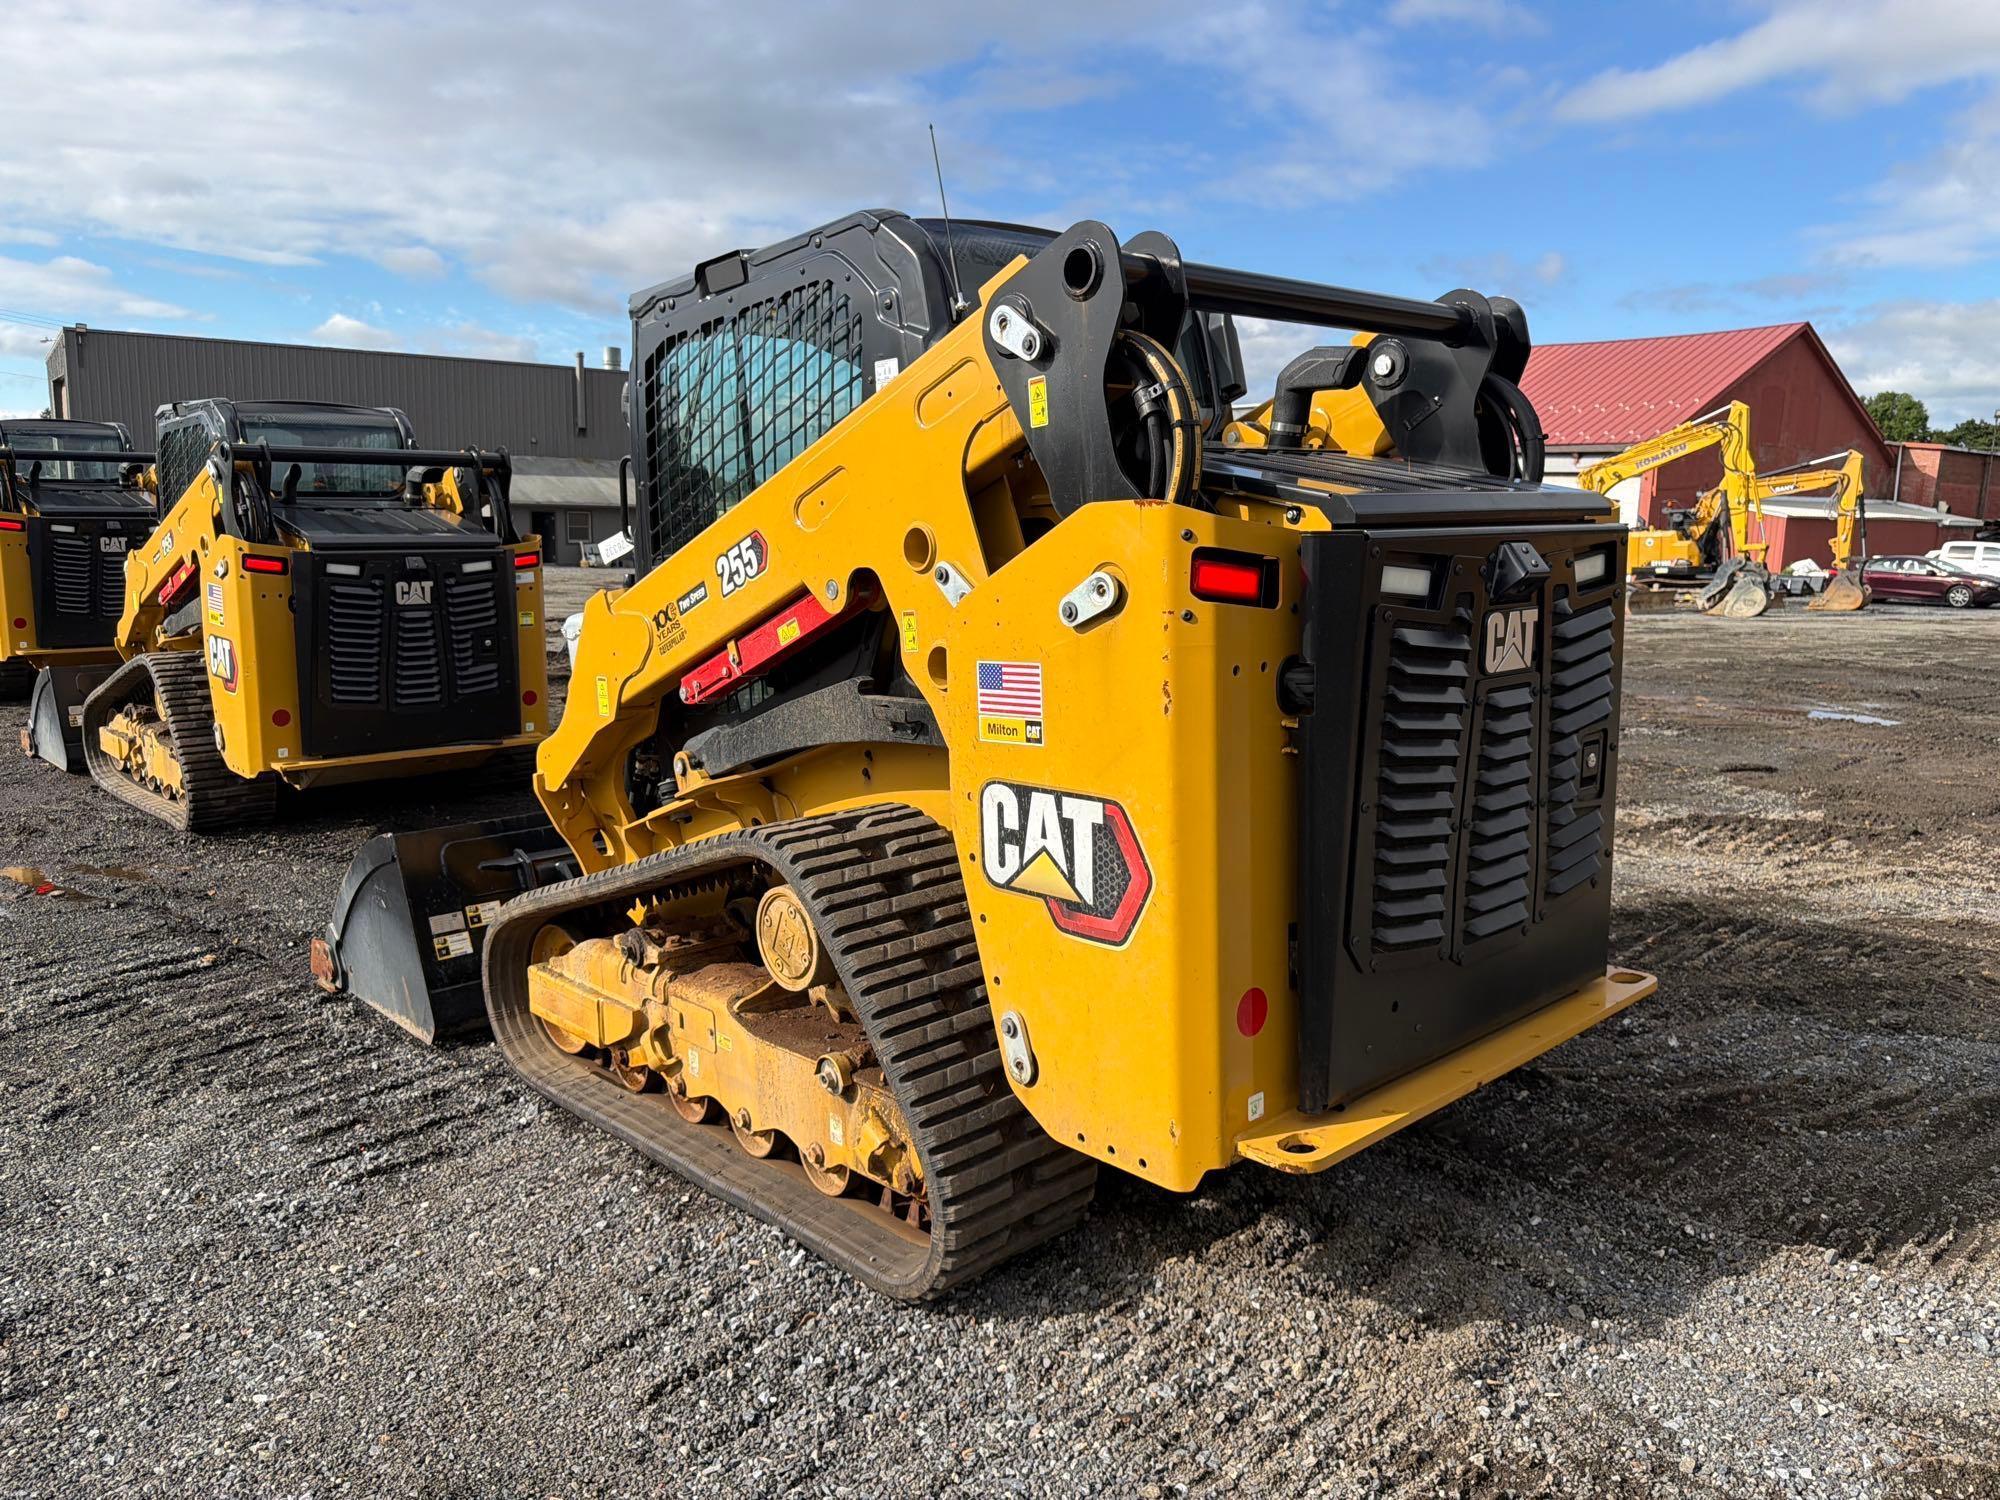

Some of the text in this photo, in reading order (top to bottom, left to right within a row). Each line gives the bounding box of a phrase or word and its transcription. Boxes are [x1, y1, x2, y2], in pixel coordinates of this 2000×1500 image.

[100, 537, 127, 552] CAT
[716, 536, 758, 596] 255
[395, 581, 433, 605] CAT
[656, 619, 681, 642] YEARS
[1485, 609, 1538, 673] CAT
[209, 635, 231, 680] CAT
[987, 723, 1041, 738] Milton CAT
[982, 783, 1104, 905] CAT
